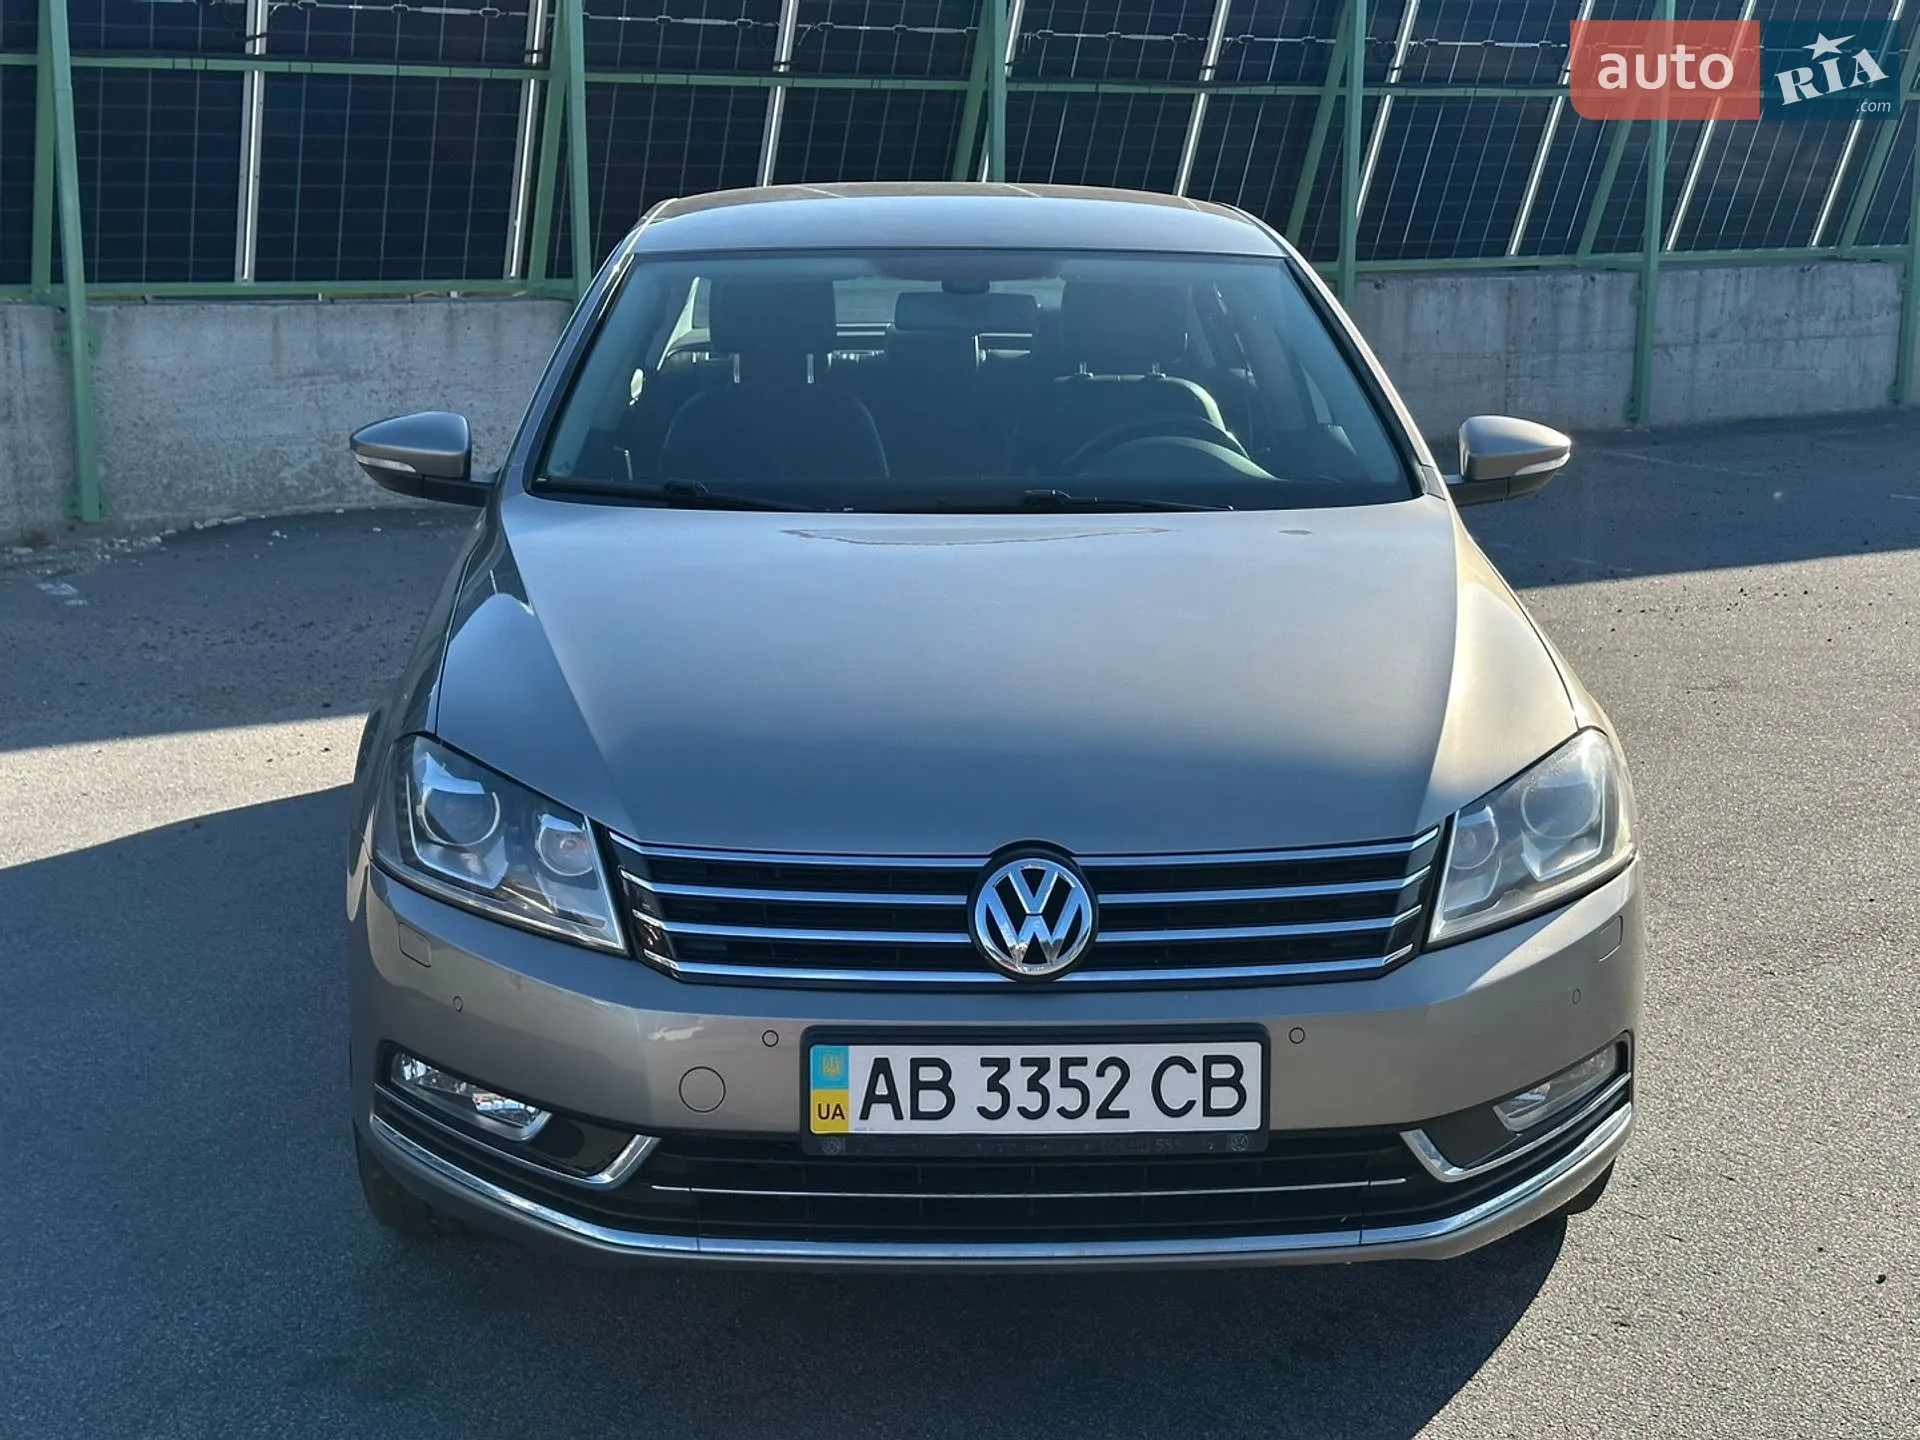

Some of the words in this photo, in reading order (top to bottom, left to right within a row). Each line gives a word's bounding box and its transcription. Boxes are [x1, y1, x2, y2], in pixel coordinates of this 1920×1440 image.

[859, 1057, 956, 1120] AB
[976, 1056, 1131, 1120] 3352
[1151, 1055, 1248, 1118] CB
[817, 1103, 845, 1120] UA
